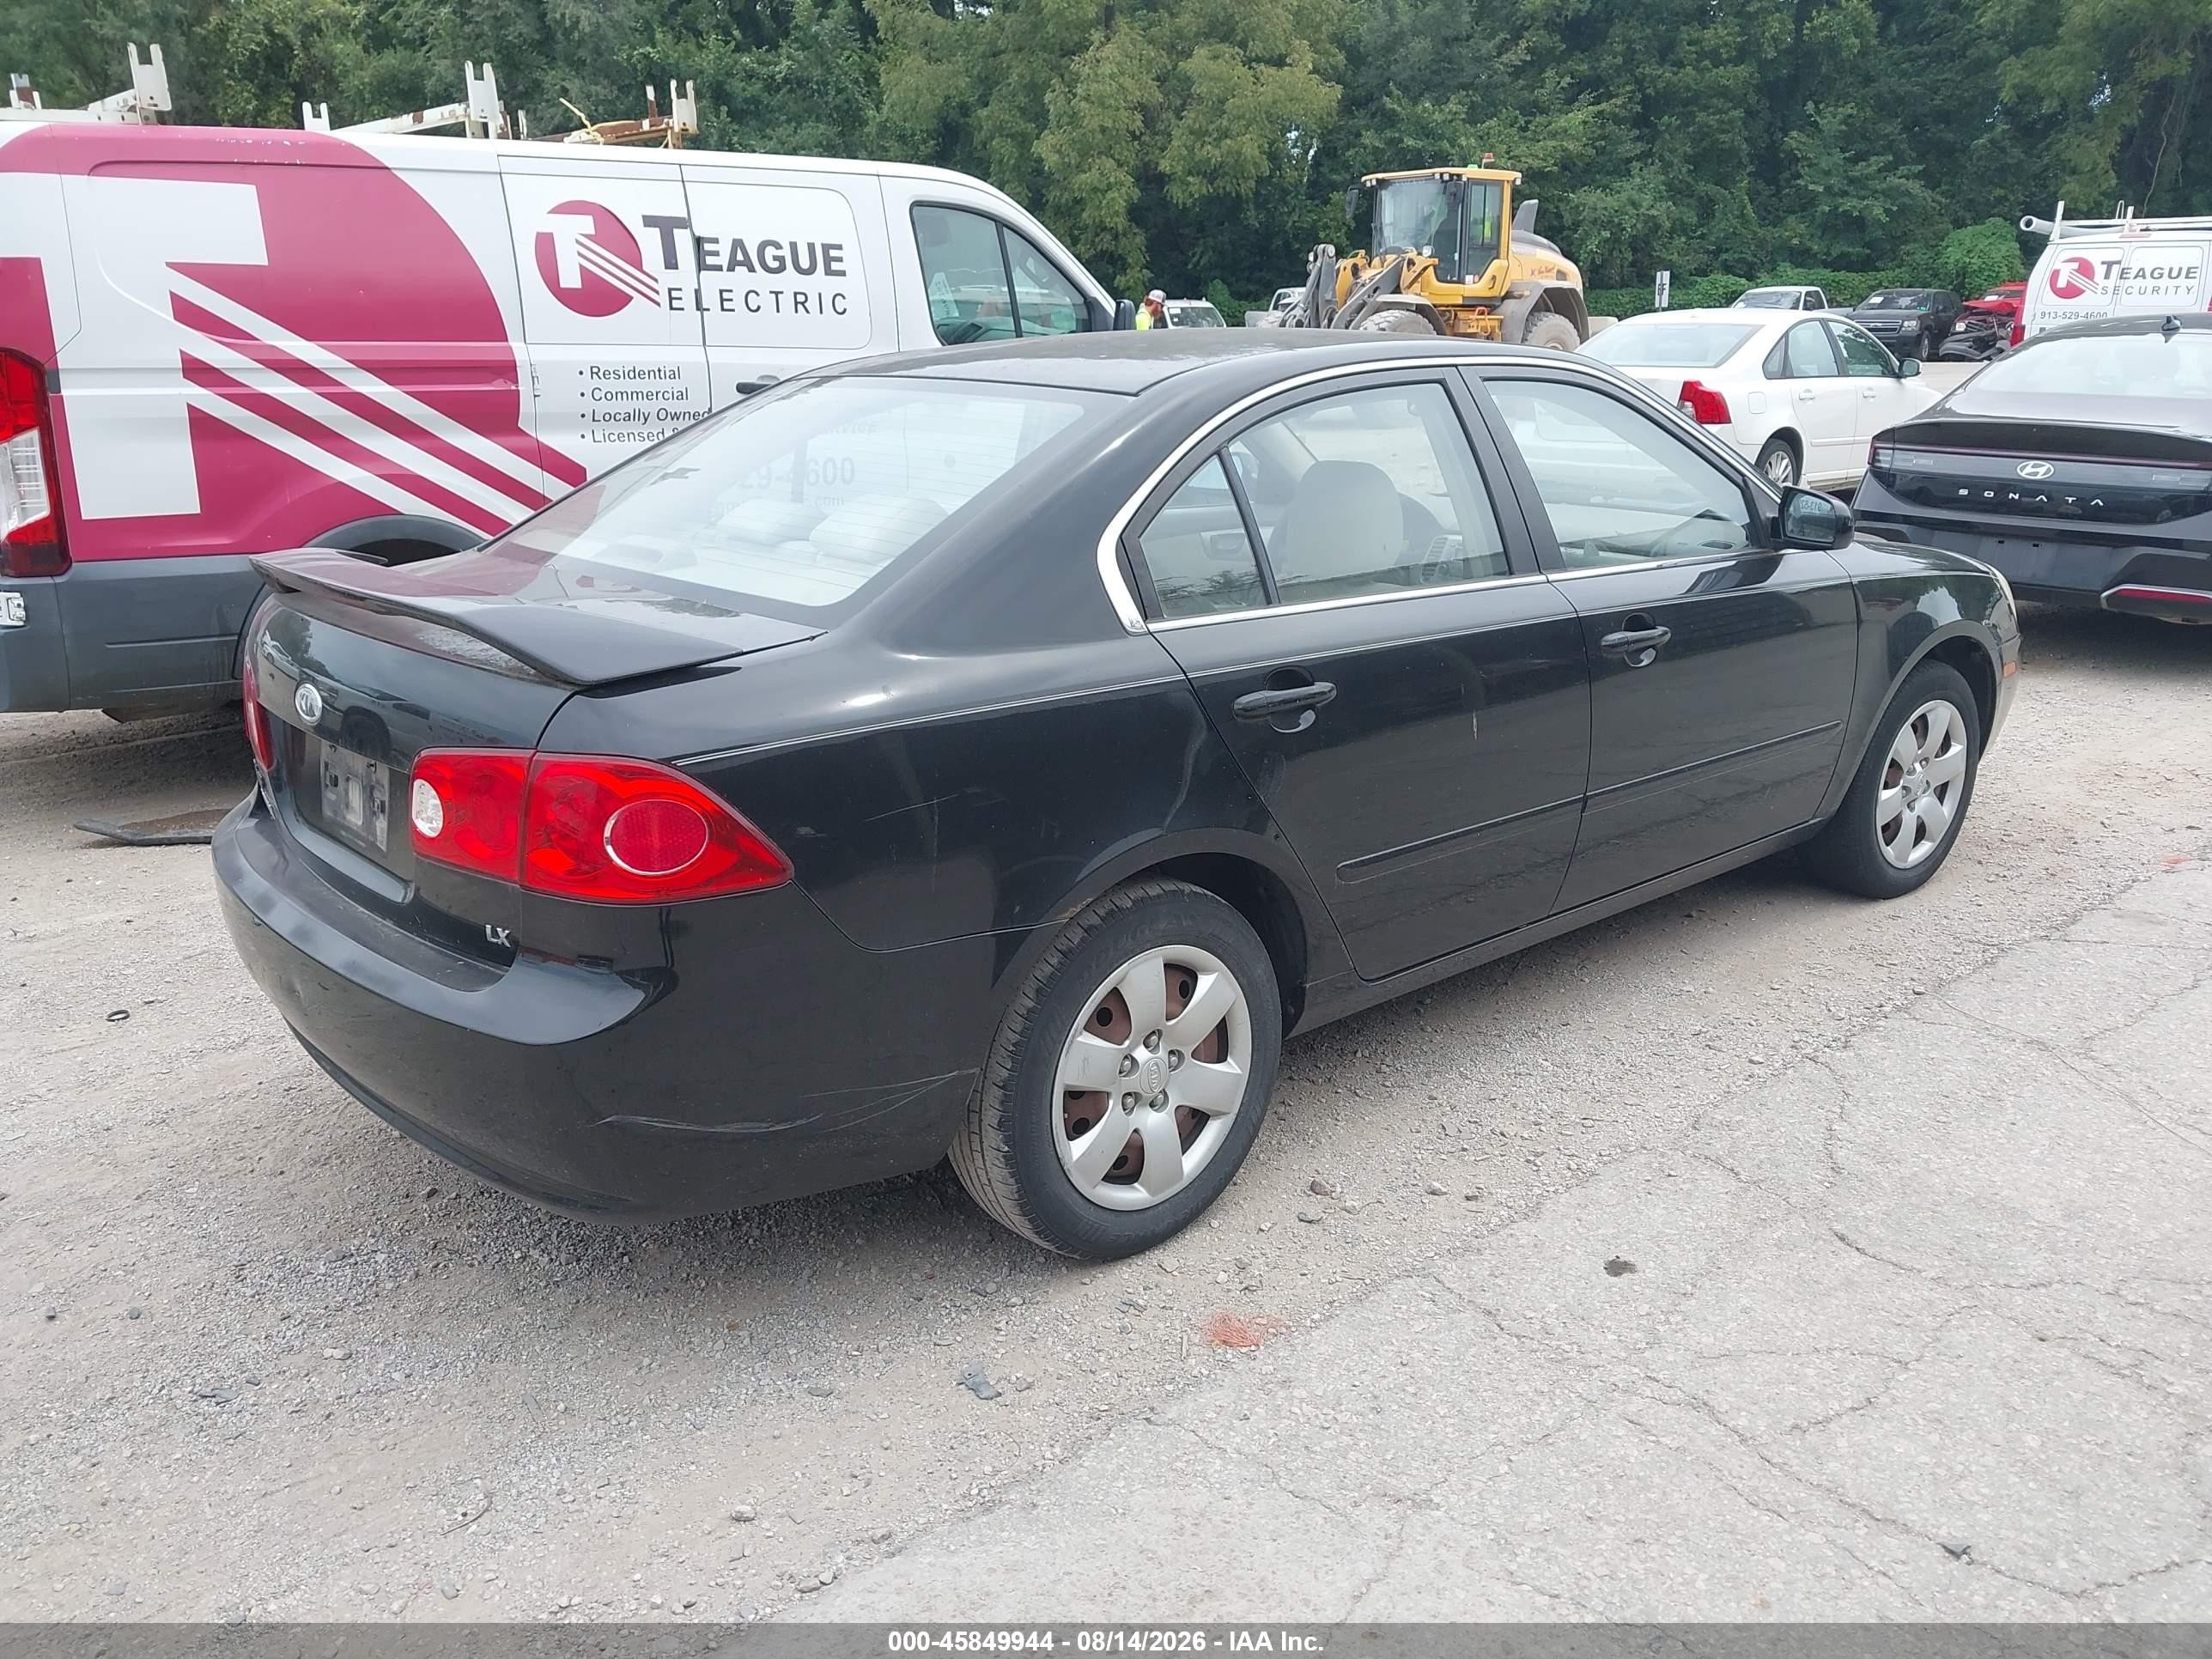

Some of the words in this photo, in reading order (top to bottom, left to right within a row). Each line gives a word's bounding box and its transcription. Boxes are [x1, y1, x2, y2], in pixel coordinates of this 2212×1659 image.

[641, 215, 847, 277] TEAGUE
[2100, 260, 2199, 280] TEAGUE
[2100, 285, 2195, 295] SECURITY
[667, 288, 848, 316] ELECTRIC
[590, 365, 681, 380] Residential
[591, 386, 689, 401] Commercial
[592, 408, 651, 425] Locally
[592, 428, 665, 443] Licensed
[1958, 488, 2105, 507] SONATA
[485, 924, 512, 948] LX
